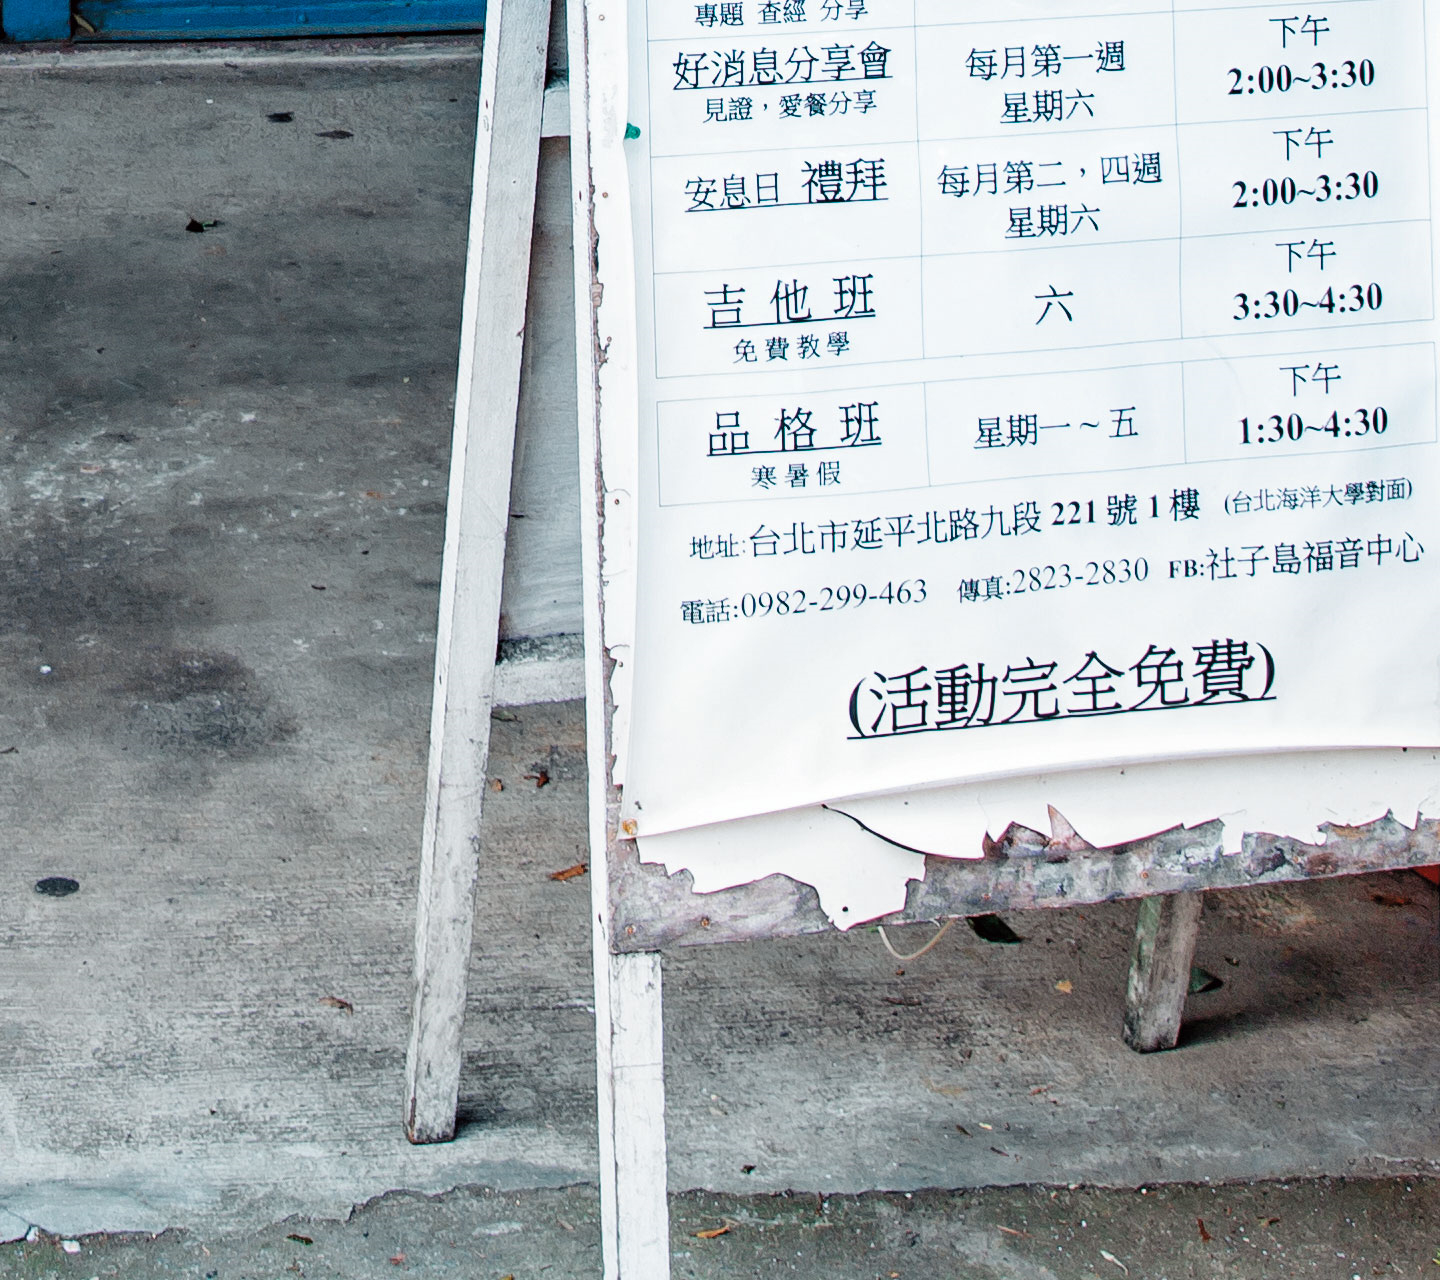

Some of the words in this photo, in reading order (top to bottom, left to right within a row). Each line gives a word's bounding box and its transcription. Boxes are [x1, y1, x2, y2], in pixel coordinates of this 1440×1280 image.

[693, 1, 745, 28] 專題
[758, 0, 808, 25] 查經
[1268, 14, 1330, 48] 下午
[672, 40, 892, 91] 好消息分享會
[965, 40, 1126, 77] 每月第一週
[1226, 57, 1376, 95] 2:00~3:30
[1000, 88, 1097, 124] 星期六
[1273, 126, 1334, 160] 下午
[685, 172, 780, 210] 安息日
[800, 157, 887, 202] 禮拜
[937, 152, 1163, 199] 每月第二，四週
[1231, 171, 1380, 210] 2:00~3:30
[1004, 202, 1101, 238] 星期六
[1275, 238, 1337, 272] 下午
[703, 273, 876, 328] 吉他班
[1034, 285, 1075, 325] 六
[1232, 282, 1383, 321] 3:30~4:30
[732, 331, 851, 363] 免費教學
[1279, 363, 1342, 397] 下午
[708, 399, 882, 457] 品格班
[1237, 406, 1389, 445] 1:30~4:30
[750, 459, 843, 488] 寒暑假
[1050, 499, 1097, 528] 221
[1106, 495, 1138, 526] 號
[1148, 495, 1160, 520] 1
[1168, 488, 1200, 521] 樓
[1223, 478, 1413, 517] (台北海洋大學對面)
[679, 578, 929, 626] 電話:0982-299-463
[957, 556, 1149, 604] 傳真:2823-2830
[1168, 535, 1425, 582] FB:社子島福音中心
[846, 638, 1276, 740] (活動完全免費)
